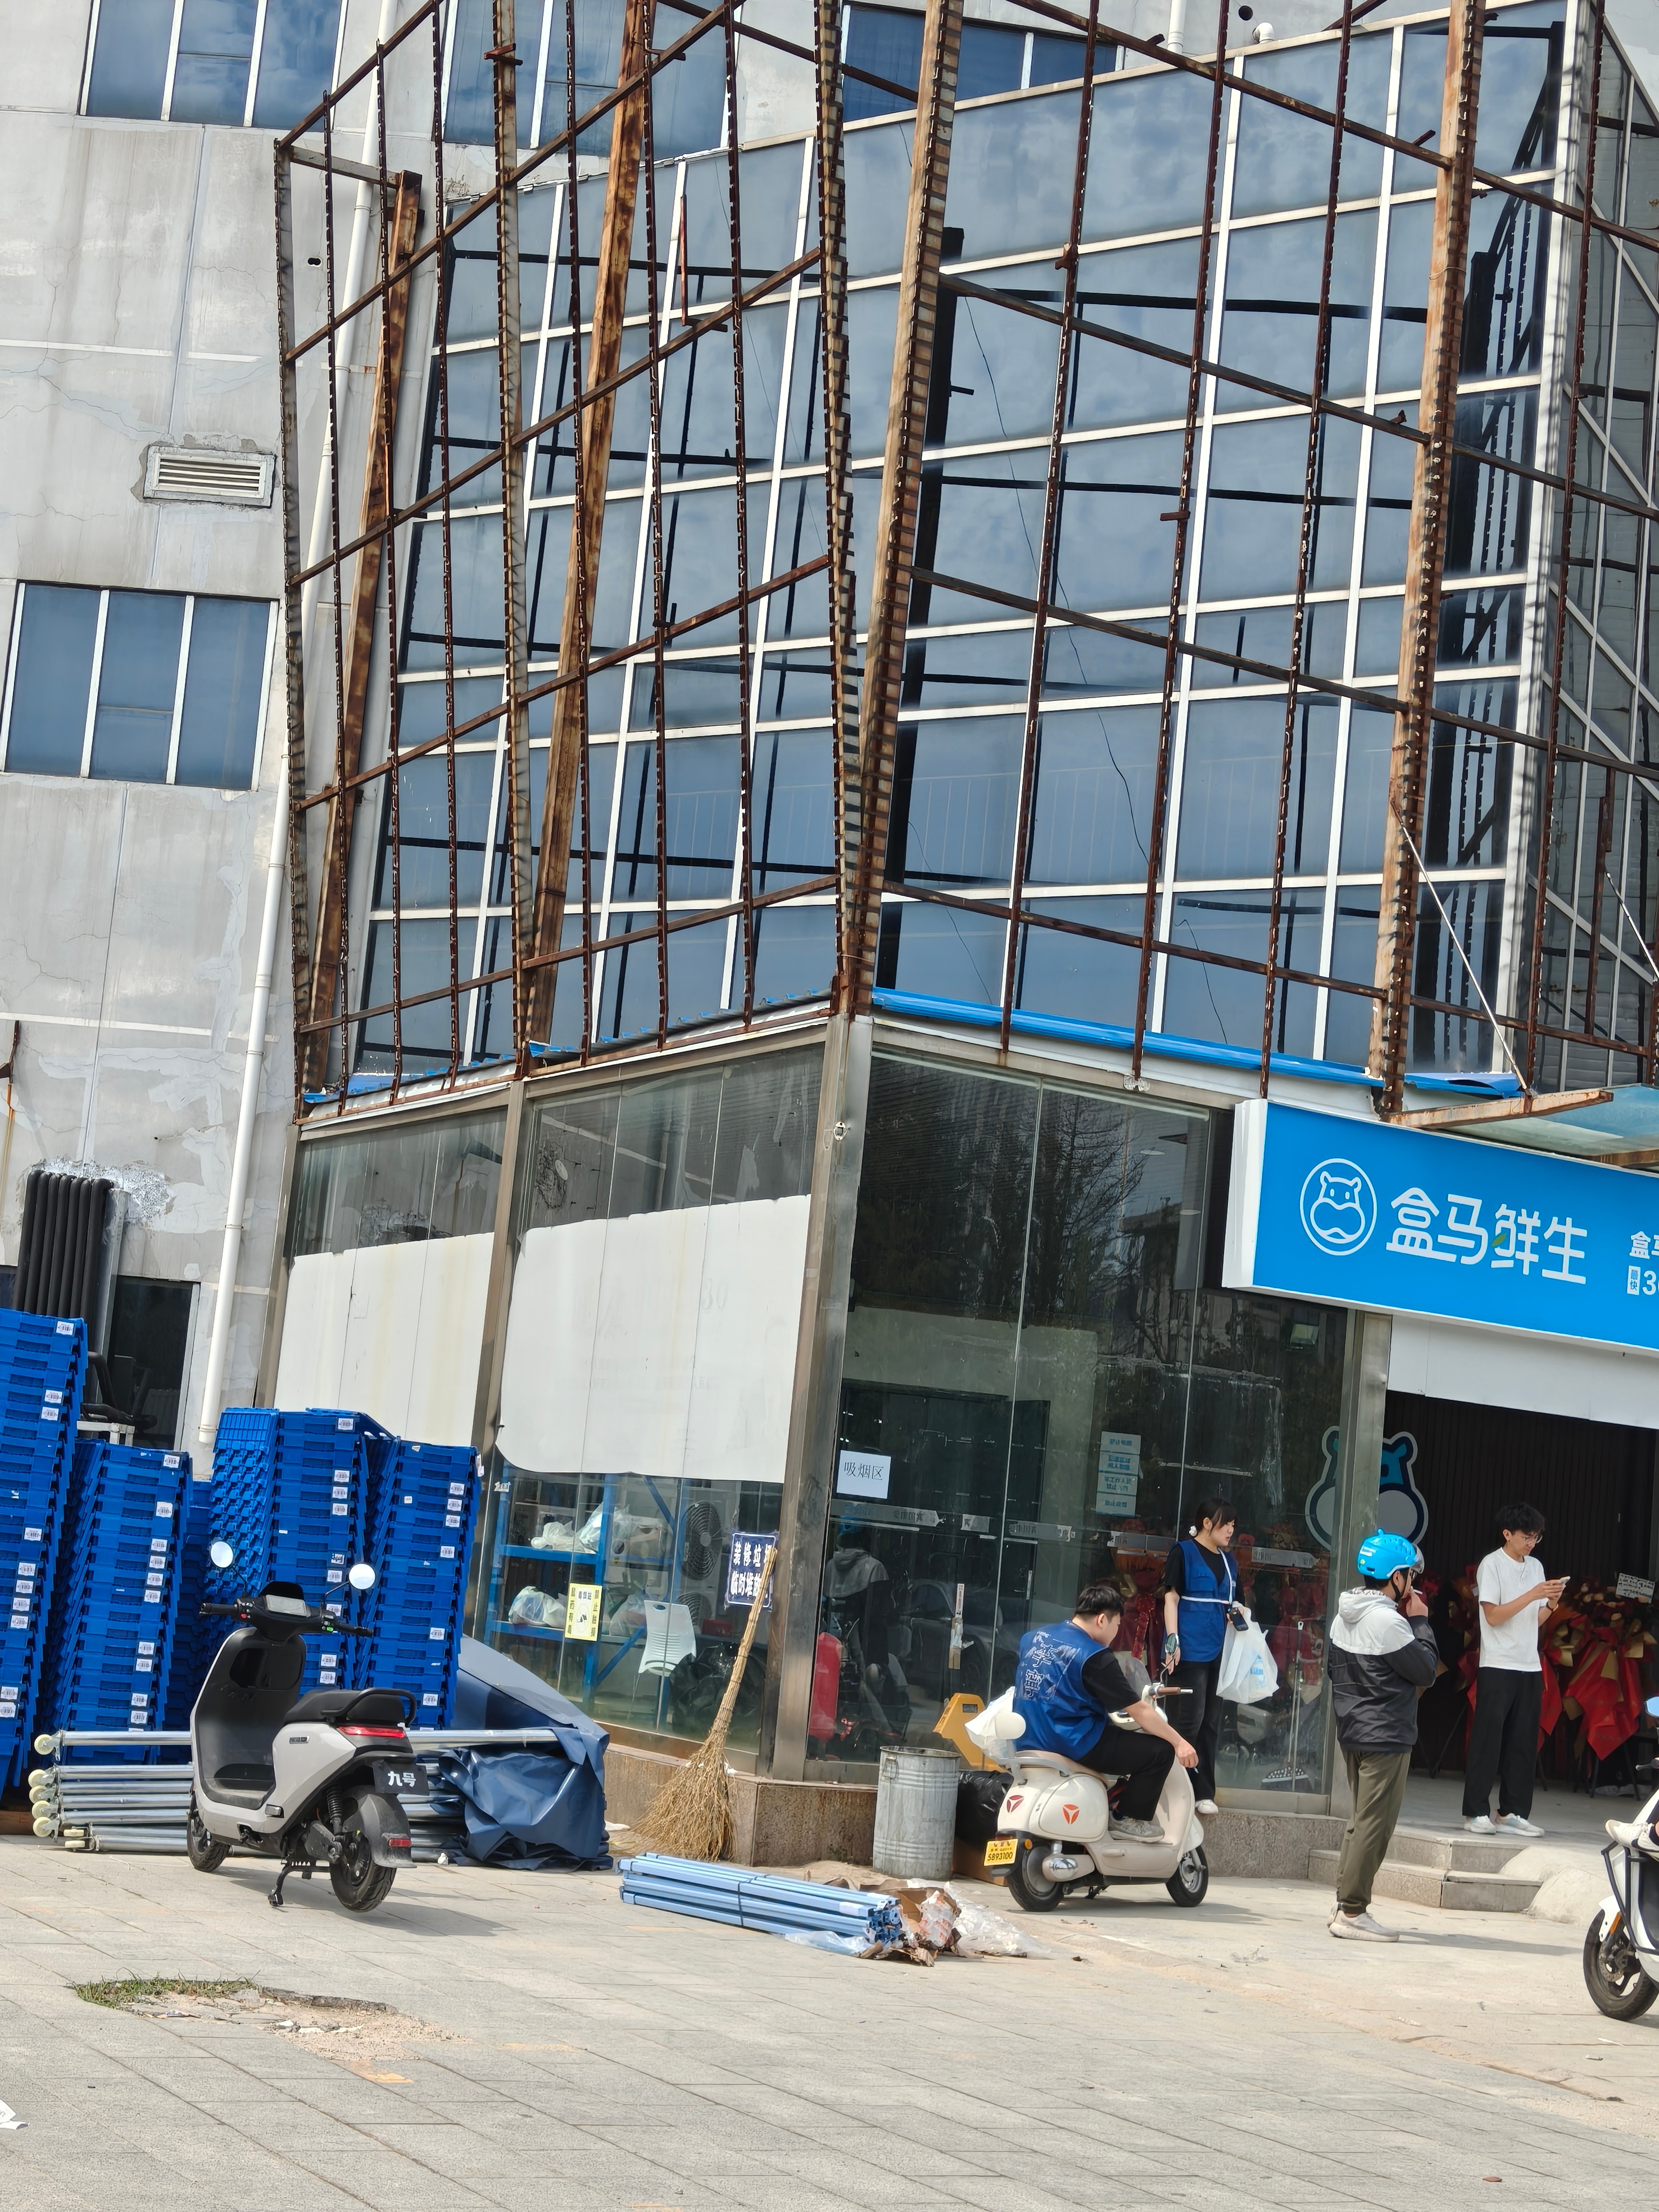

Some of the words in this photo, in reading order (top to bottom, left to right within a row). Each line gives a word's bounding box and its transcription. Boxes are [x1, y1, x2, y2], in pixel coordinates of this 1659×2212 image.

[1386, 1188, 1587, 1284] 盒马鲜生
[1642, 1270, 1659, 1296] 3
[844, 1462, 884, 1480] 吸烟区
[733, 1541, 772, 1567] 装修垃
[731, 1570, 769, 1599] 临时堆放
[387, 1771, 416, 1788] 九号
[987, 1851, 1013, 1861] 5893100
